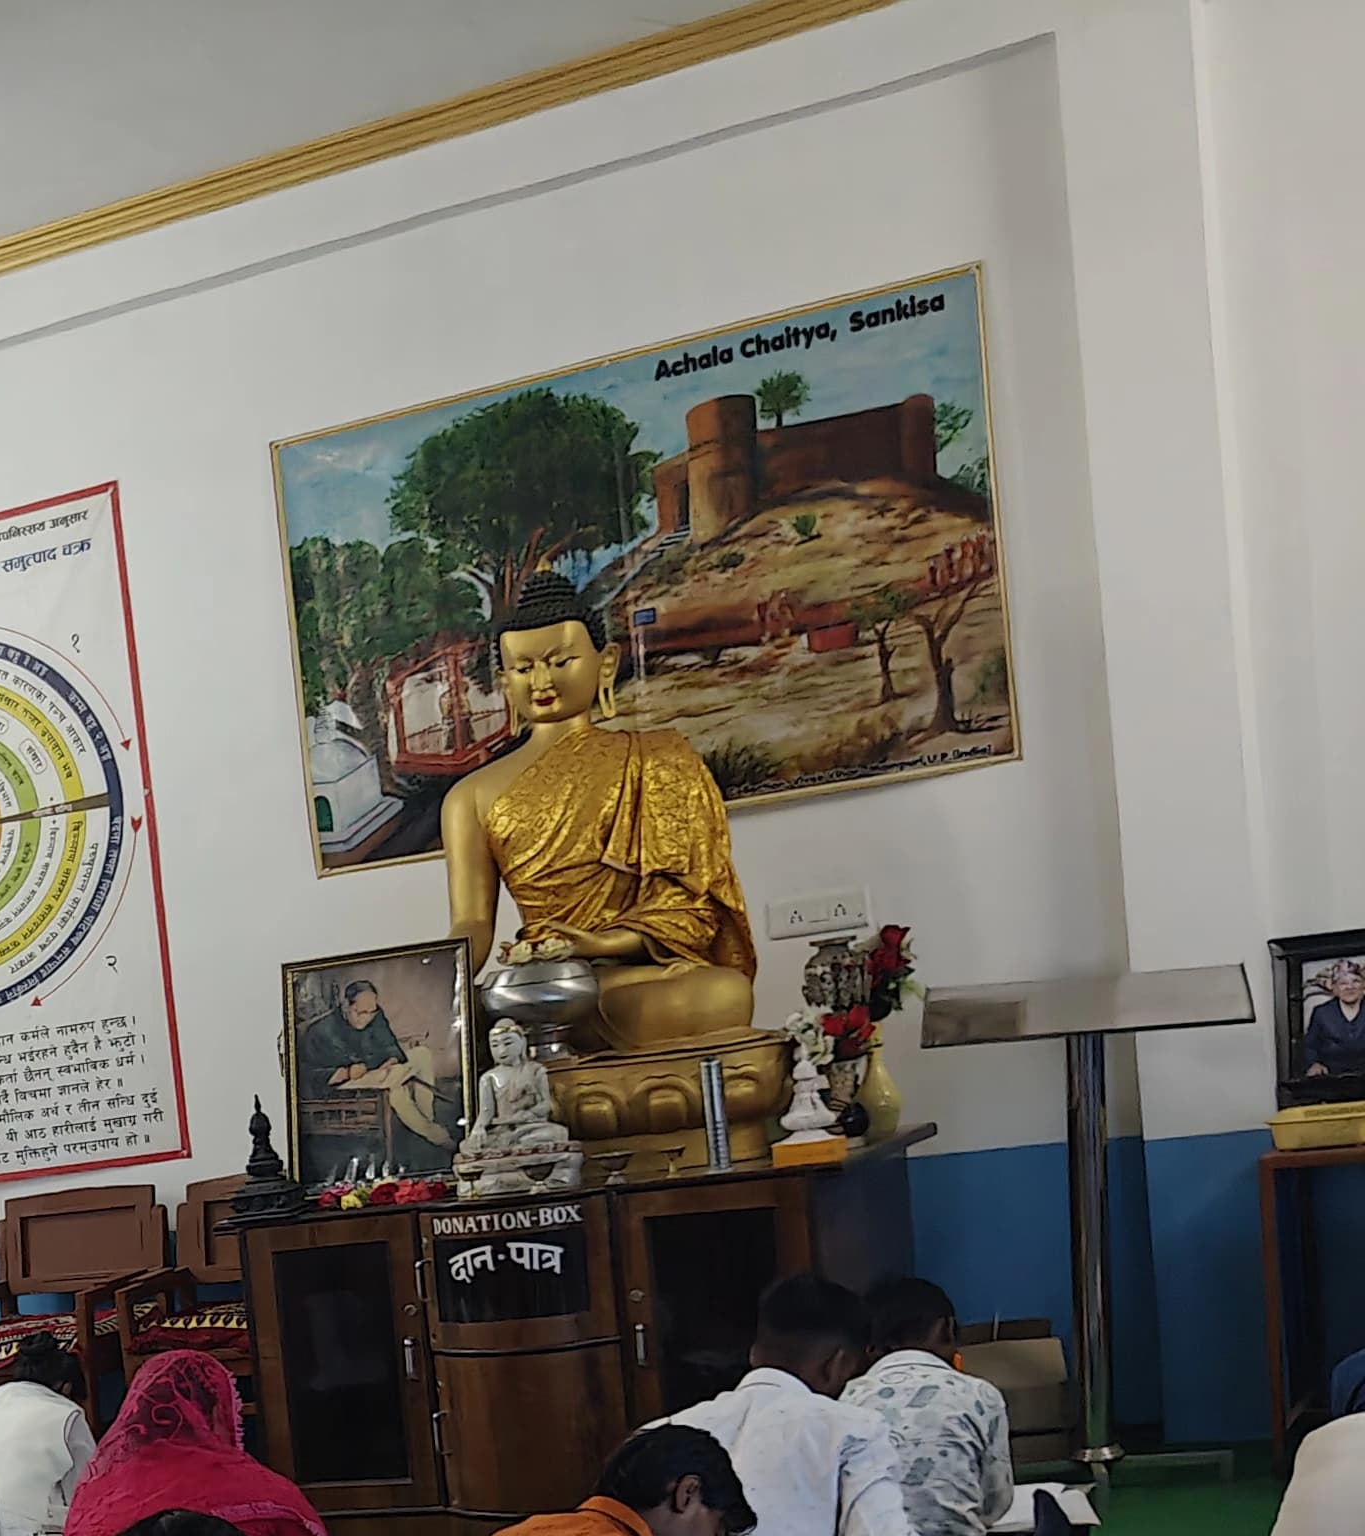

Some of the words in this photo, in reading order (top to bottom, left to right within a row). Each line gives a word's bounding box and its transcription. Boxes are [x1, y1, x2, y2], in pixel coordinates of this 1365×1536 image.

[655, 345, 734, 381] Achala
[740, 320, 838, 359] Chaitya,
[849, 294, 945, 332] Sankisa
[432, 1205, 582, 1235] DONATION-BOX
